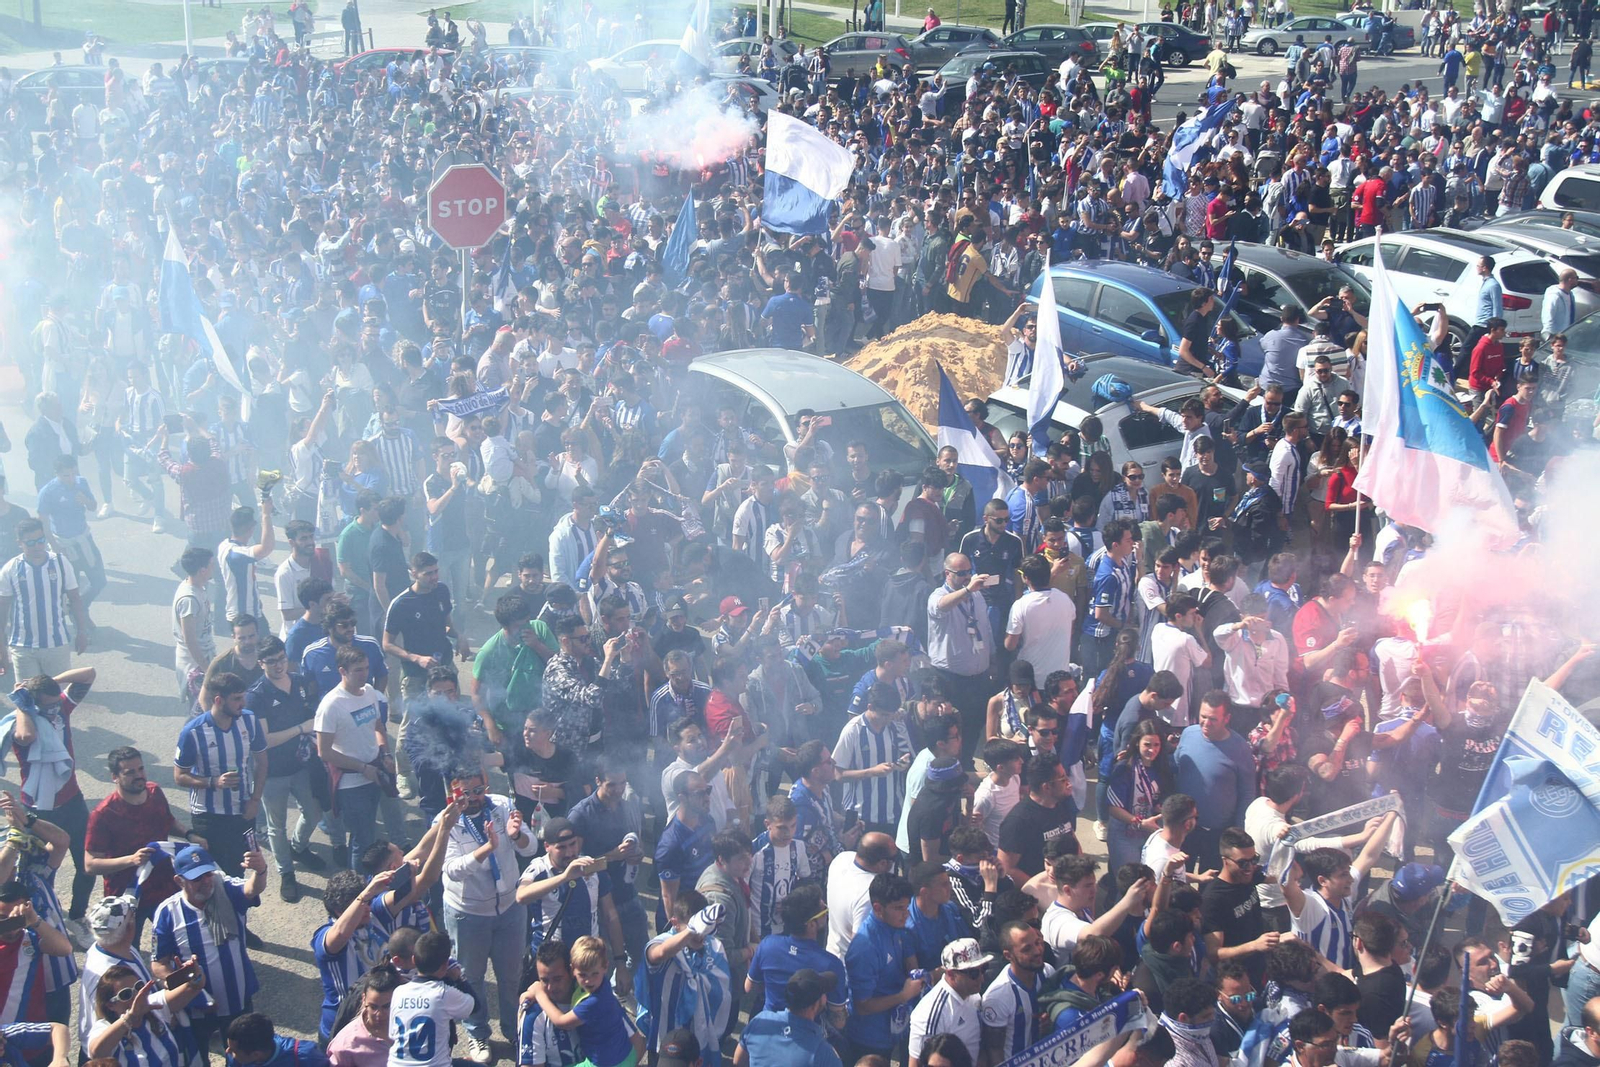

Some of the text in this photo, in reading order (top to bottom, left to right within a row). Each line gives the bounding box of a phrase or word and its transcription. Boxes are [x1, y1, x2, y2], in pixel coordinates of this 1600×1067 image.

[438, 197, 498, 218] STOP
[398, 996, 430, 1009] JESÚS
[394, 1015, 436, 1061] 10
[1013, 1052, 1031, 1065] Club
[1033, 1026, 1076, 1054] Recreativo
[1079, 1018, 1090, 1027] de
[1091, 1001, 1118, 1020] Huelva
